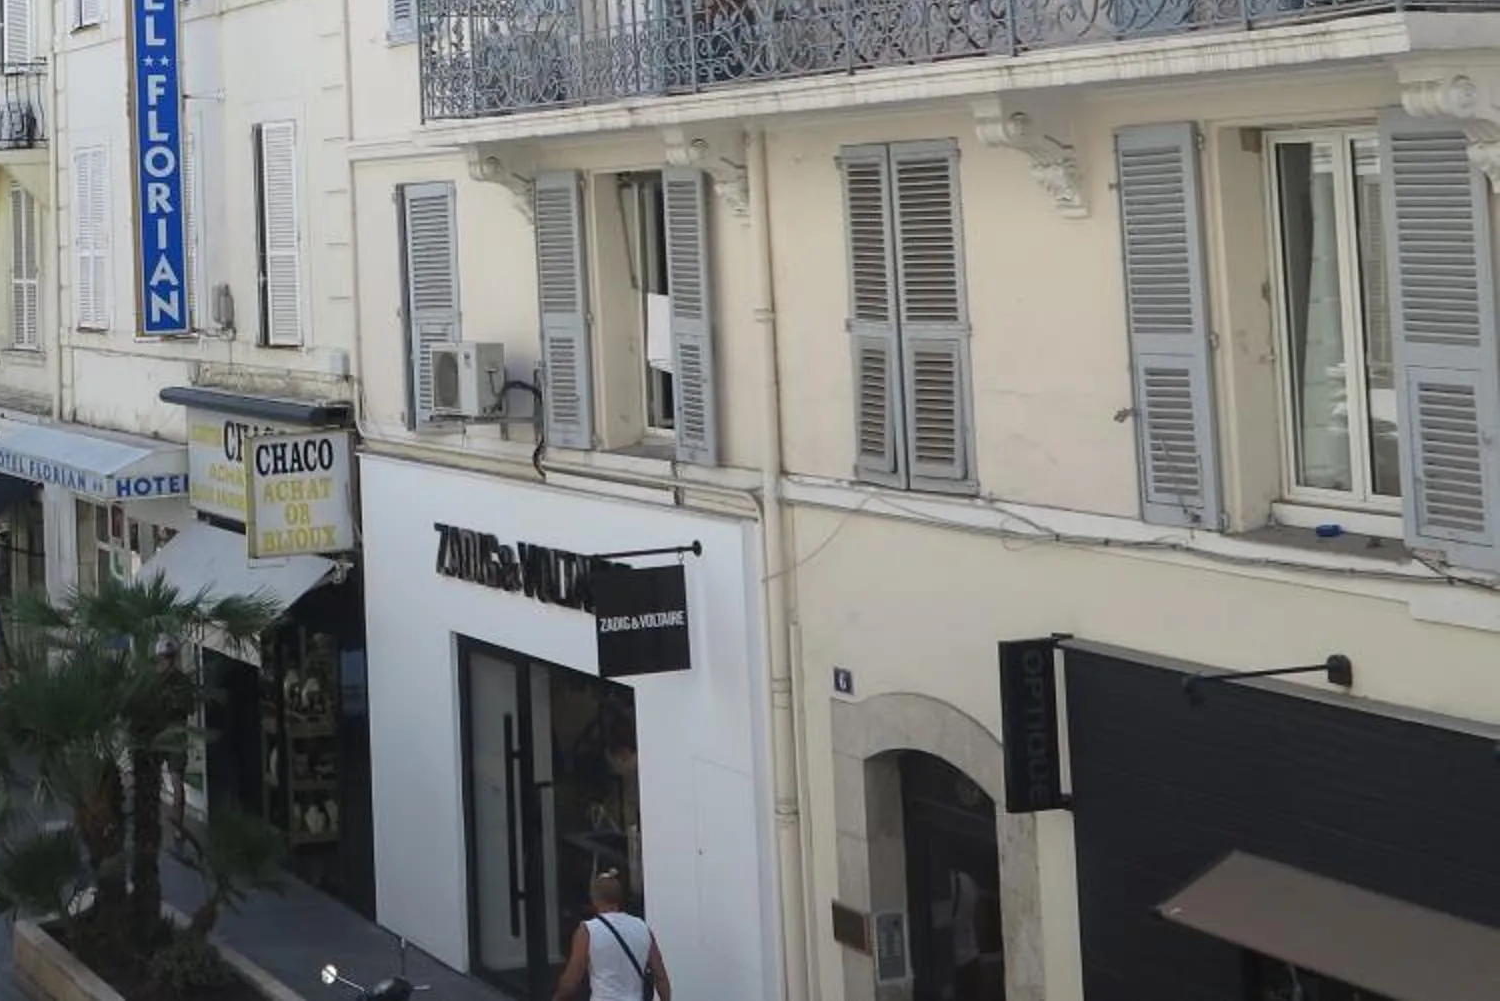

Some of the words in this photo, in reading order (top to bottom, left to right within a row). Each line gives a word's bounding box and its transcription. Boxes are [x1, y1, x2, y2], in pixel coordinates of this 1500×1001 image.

[143, 74, 180, 324] FLORIAN
[255, 438, 334, 477] CHACO
[29, 459, 88, 492] FLORIAN
[262, 478, 332, 502] ACHAT
[285, 502, 311, 526] OR
[262, 525, 337, 552] BIJOUX
